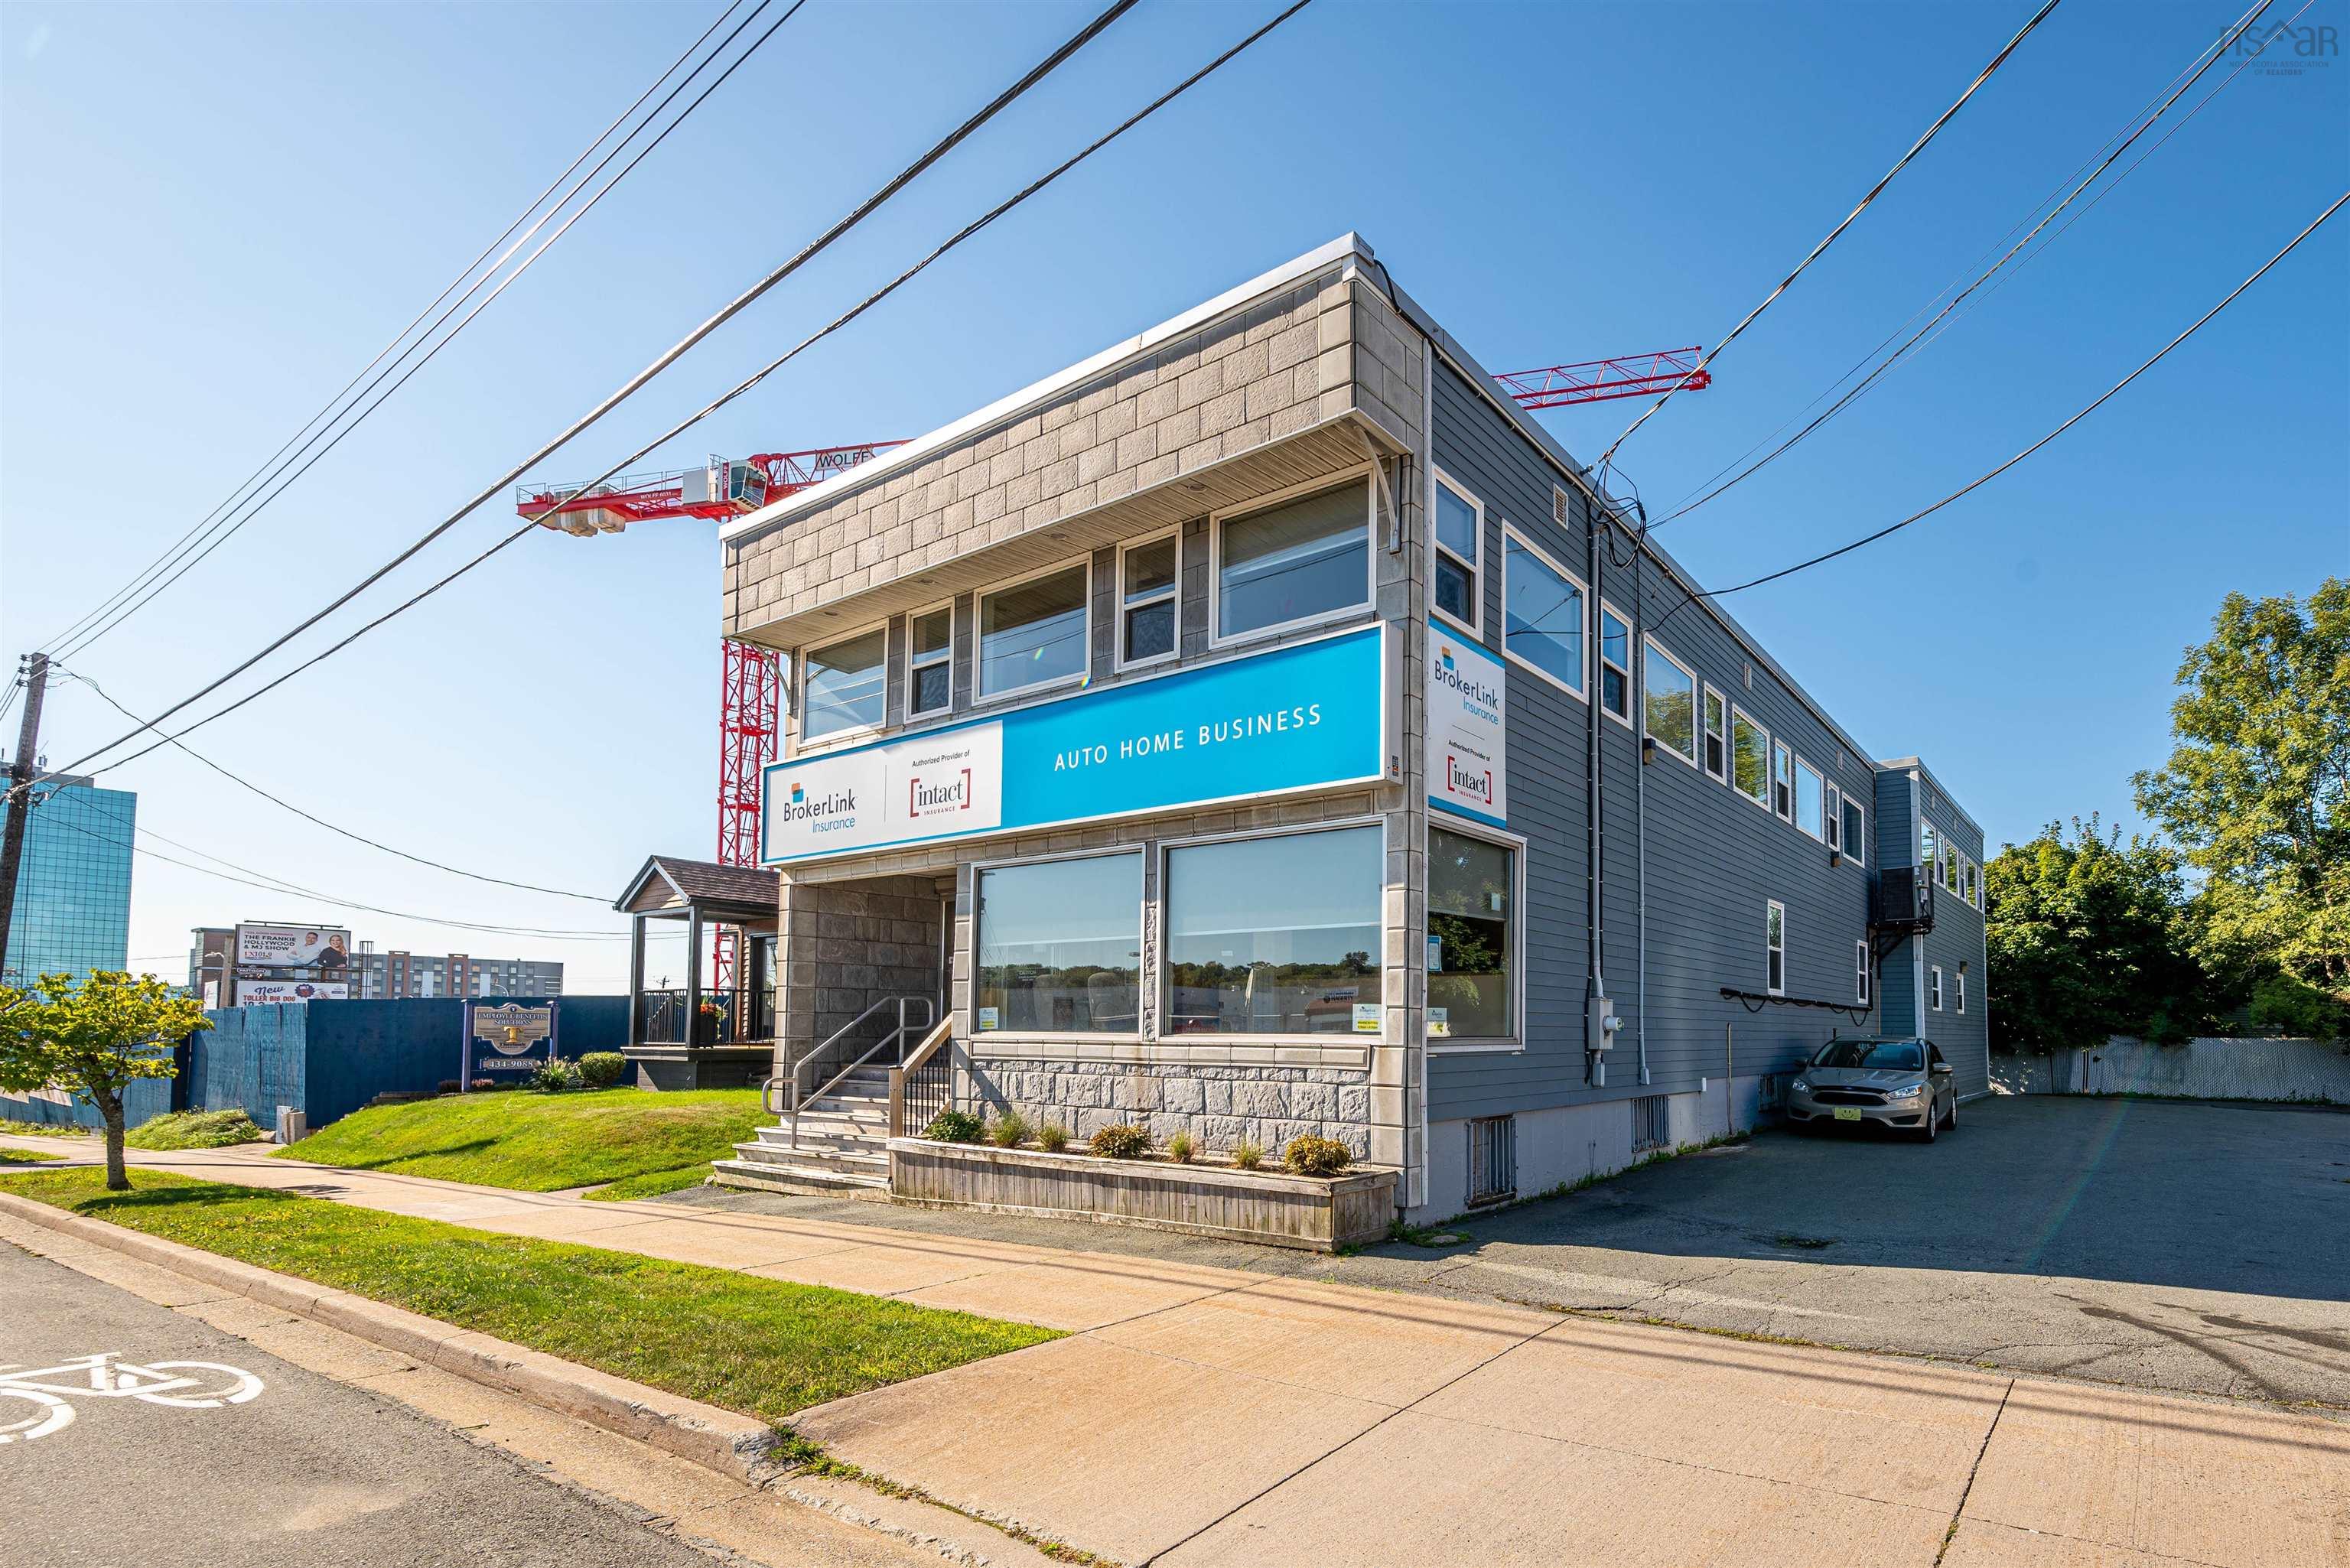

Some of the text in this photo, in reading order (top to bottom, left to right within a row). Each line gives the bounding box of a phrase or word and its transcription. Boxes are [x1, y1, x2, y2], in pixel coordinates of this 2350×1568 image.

[820, 451, 869, 467] WOLFF
[1435, 660, 1499, 710] BrokerLink
[1463, 696, 1499, 724] Insurance
[1054, 704, 1321, 771] AUTO HOME BUSINESS
[912, 749, 970, 767] Authorized Provider of
[1448, 740, 1470, 753] Authorized
[1470, 749, 1486, 760] Provider
[1453, 764, 1486, 795] intact
[918, 779, 963, 806] intact
[1459, 790, 1482, 802] INSURANCE
[784, 789, 856, 821] BrokerLink
[924, 806, 955, 816] INSURANCE
[812, 817, 855, 833] Insurance
[255, 987, 285, 996] New
